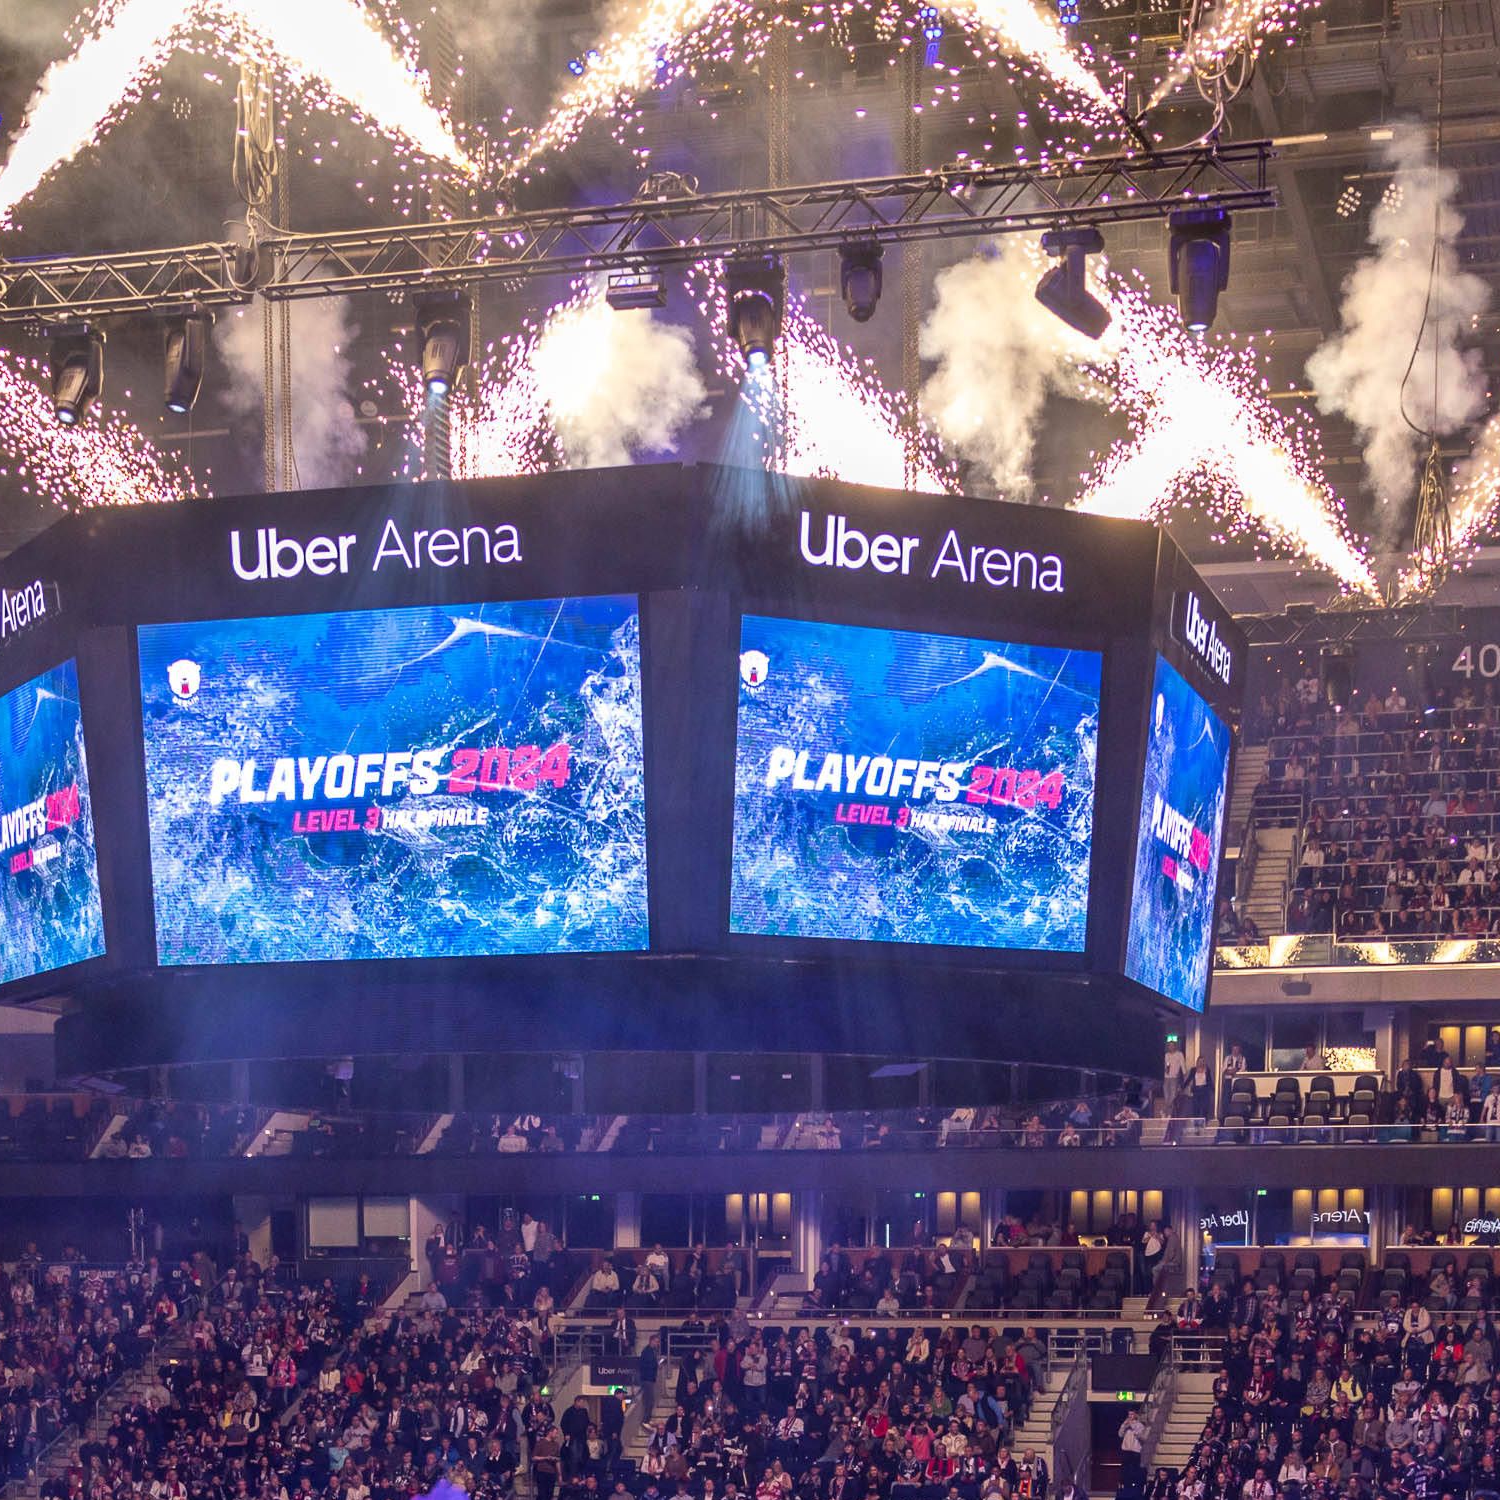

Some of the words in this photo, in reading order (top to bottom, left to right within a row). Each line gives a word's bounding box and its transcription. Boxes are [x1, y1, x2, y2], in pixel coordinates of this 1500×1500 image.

[230, 527, 357, 581] Uber
[372, 519, 522, 572] Arena
[800, 511, 920, 575] Uber
[931, 529, 1064, 593] Arena
[1, 579, 46, 638] Arena
[1186, 591, 1210, 655] Uber
[1206, 620, 1231, 685] Arena
[209, 750, 442, 806] PLAYOFFS
[448, 744, 572, 794] 2024
[766, 746, 964, 803] PLAYOFFS
[966, 765, 1066, 810] 2024
[292, 808, 361, 834] LEVEL
[363, 807, 380, 831] 3
[835, 803, 893, 827] LEVEL
[896, 806, 909, 828] 3
[1152, 791, 1193, 860] PLAYOFFS
[597, 1367, 616, 1375] Uber
